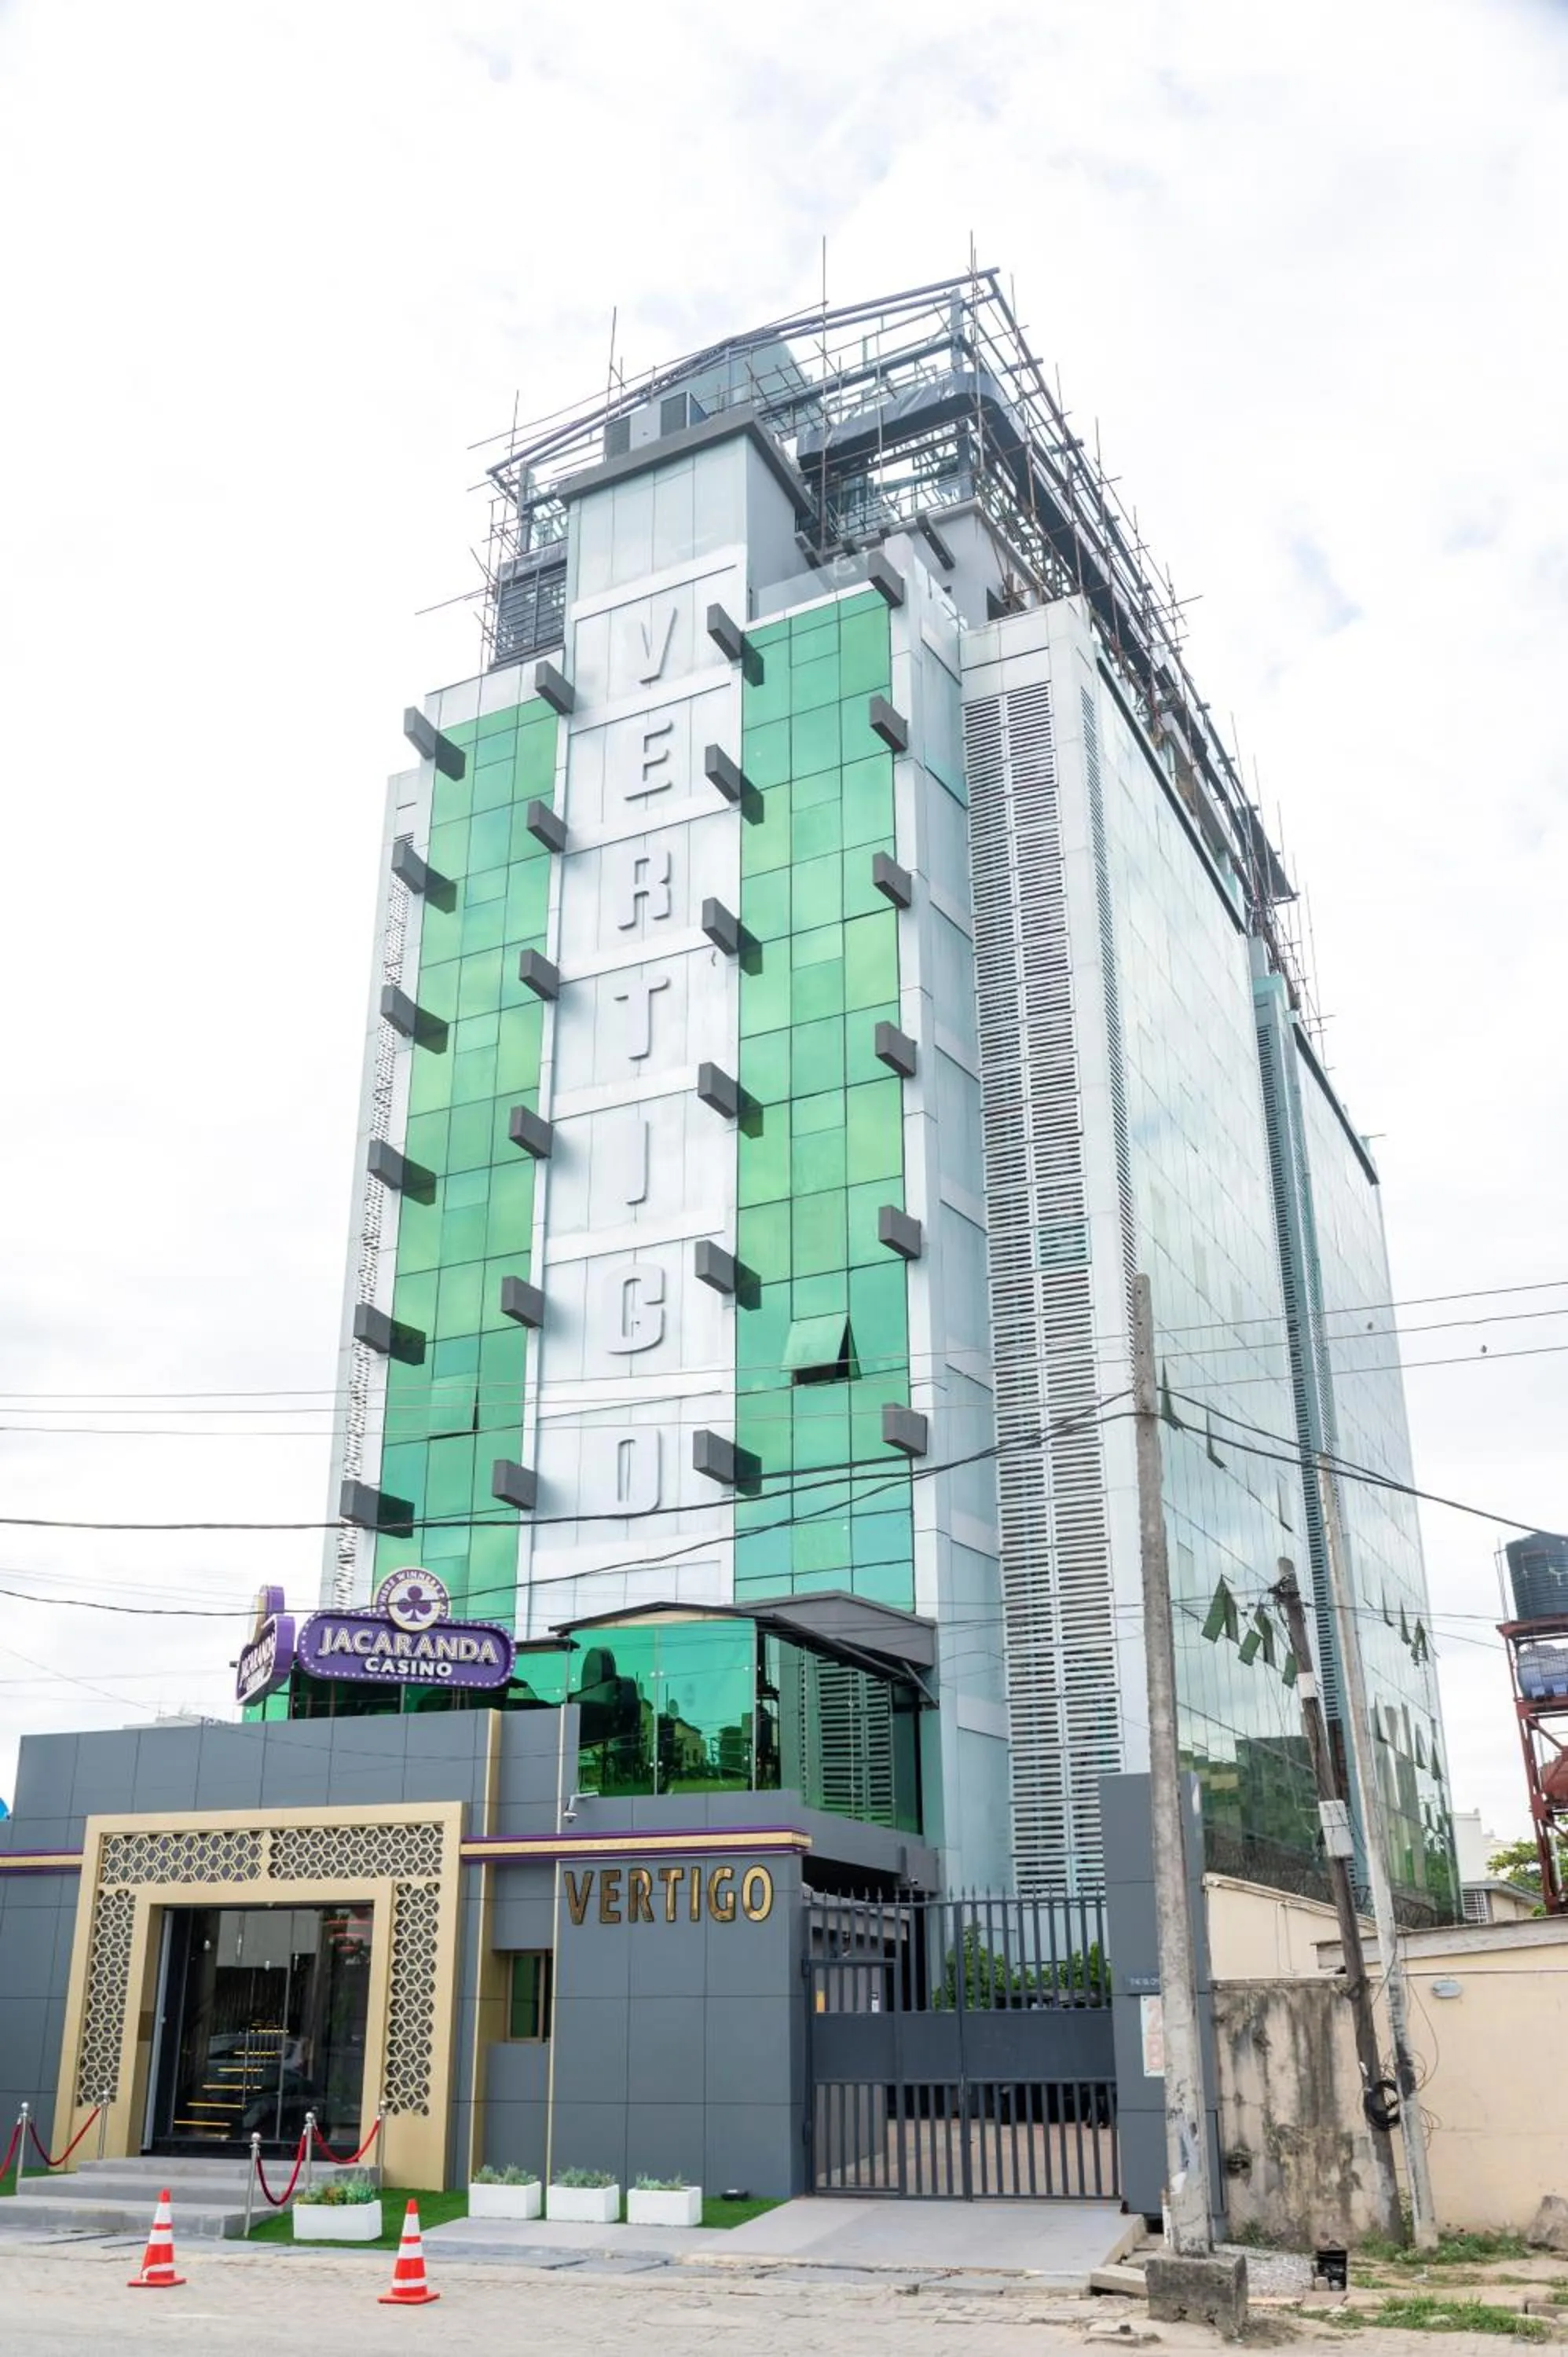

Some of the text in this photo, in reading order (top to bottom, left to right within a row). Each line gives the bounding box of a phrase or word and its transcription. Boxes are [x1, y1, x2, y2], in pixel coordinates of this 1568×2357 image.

[601, 604, 678, 1514] VERTIGO
[317, 1626, 500, 1665] JACARANDA
[365, 1656, 453, 1678] CASINO
[563, 1864, 774, 1926] VERTIGO
